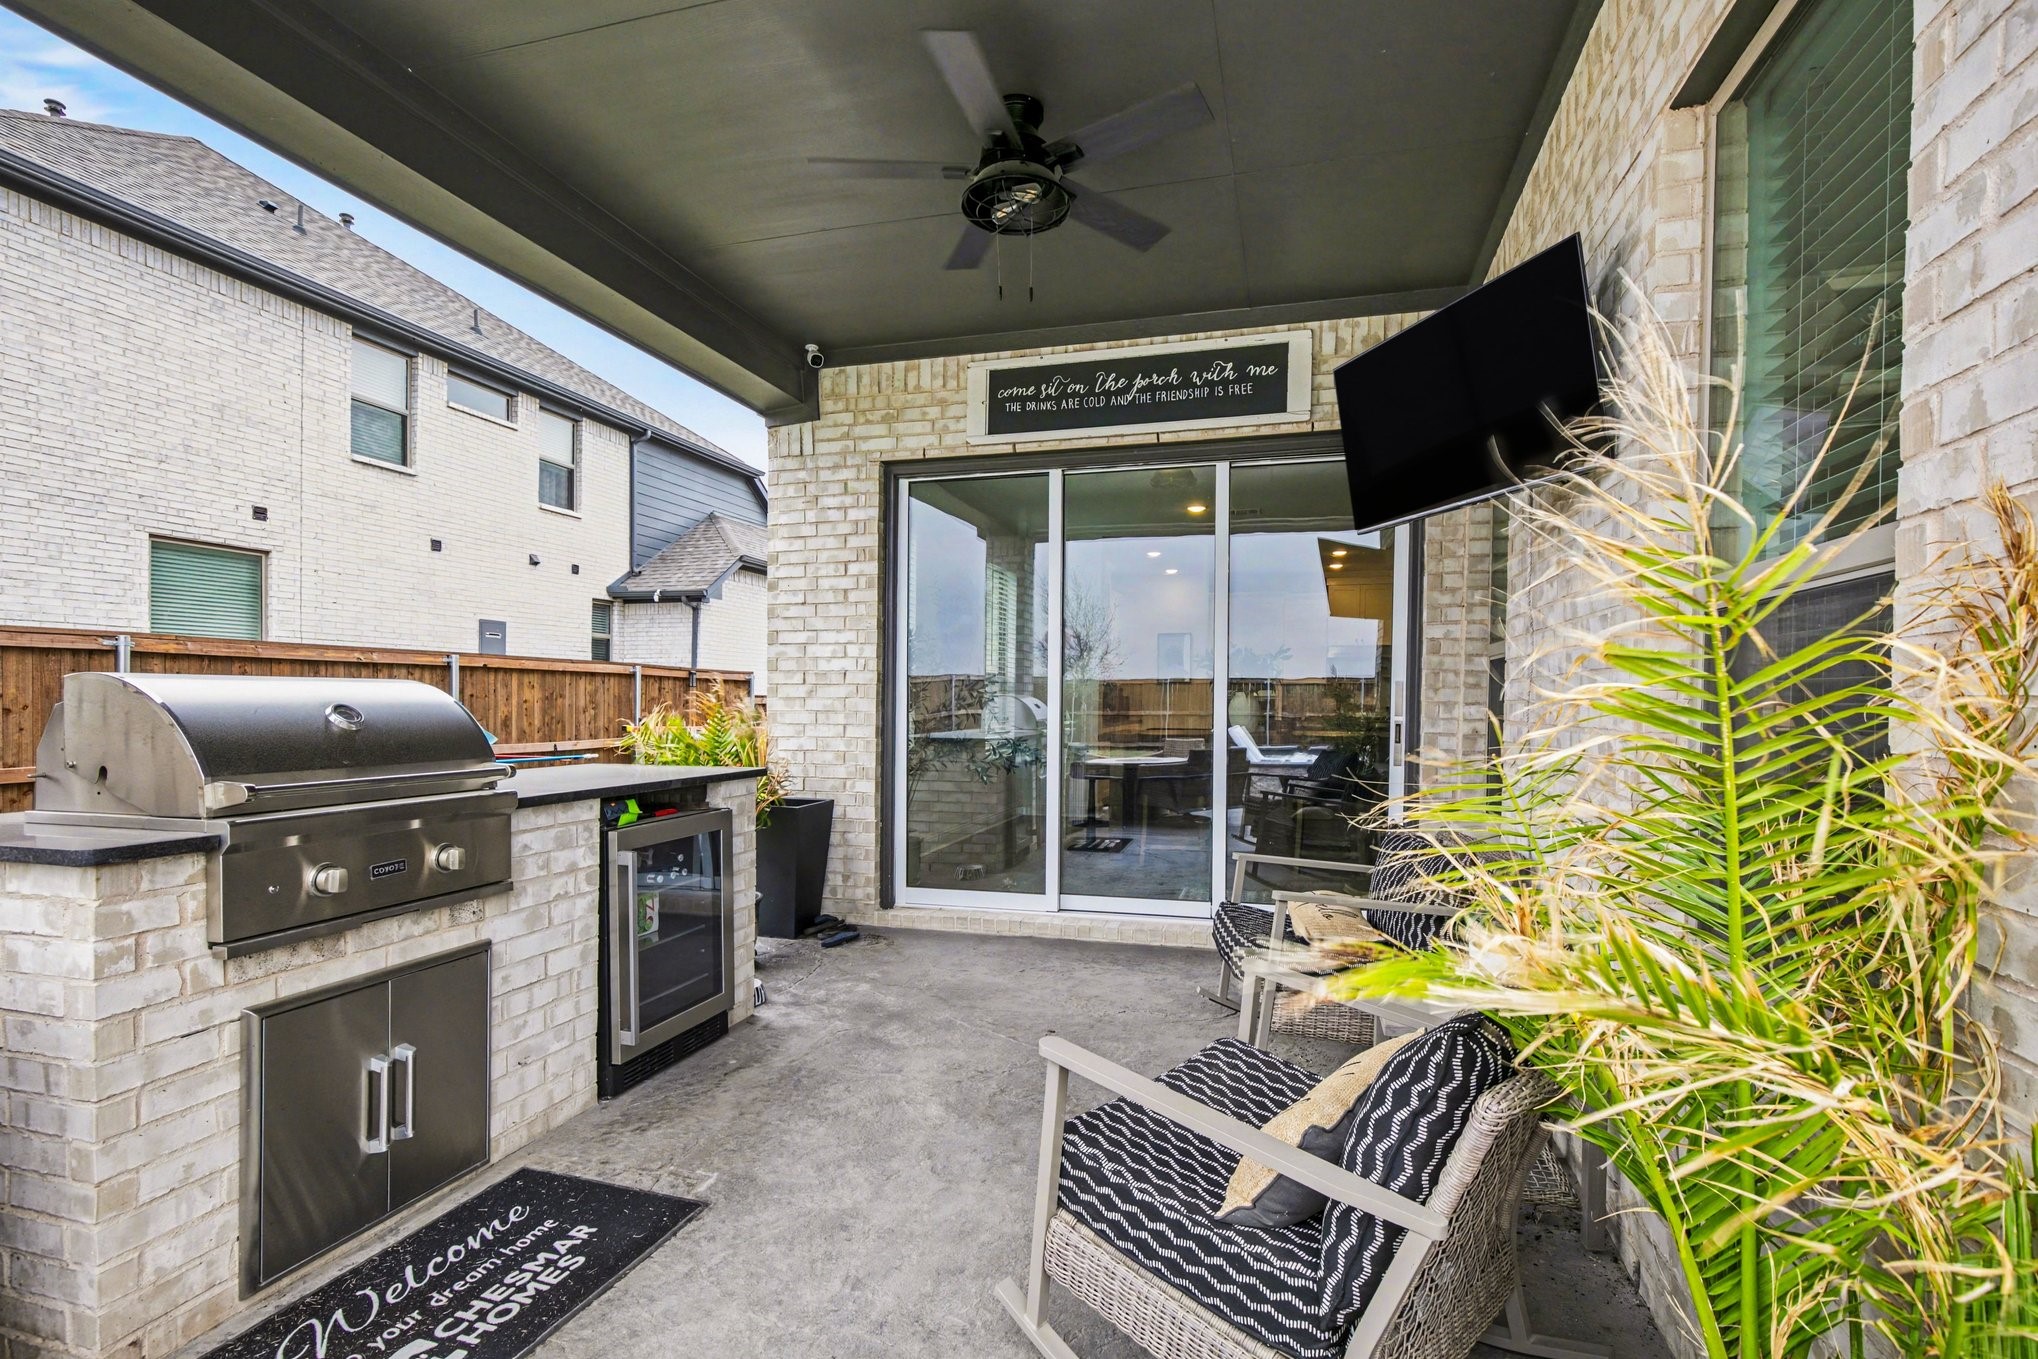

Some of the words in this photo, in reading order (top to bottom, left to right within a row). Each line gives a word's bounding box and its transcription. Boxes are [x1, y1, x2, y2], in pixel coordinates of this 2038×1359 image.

[998, 385, 1036, 398] come
[1040, 375, 1070, 398] sit
[1067, 383, 1089, 394] on
[1095, 371, 1128, 392] the
[1129, 368, 1182, 400] porch
[1190, 361, 1238, 385] with
[1246, 365, 1278, 376] me
[1005, 402, 1021, 412] THE
[1026, 401, 1057, 411] DRINKS
[1061, 398, 1080, 409] ARE
[1083, 396, 1106, 408] COLD
[1110, 394, 1130, 406] AND
[1135, 392, 1152, 404] THE
[1156, 387, 1210, 402] FRIENDSHIP
[1215, 386, 1224, 396] IS
[1229, 383, 1254, 395] FREE
[373, 862, 405, 874] COYOTE
[274, 1205, 530, 1359] Welcome
[367, 1310, 423, 1351] your
[430, 1257, 502, 1307] dream
[500, 1219, 560, 1256] home
[434, 1225, 599, 1338] CHESMAR
[456, 1254, 586, 1345] HOMES
